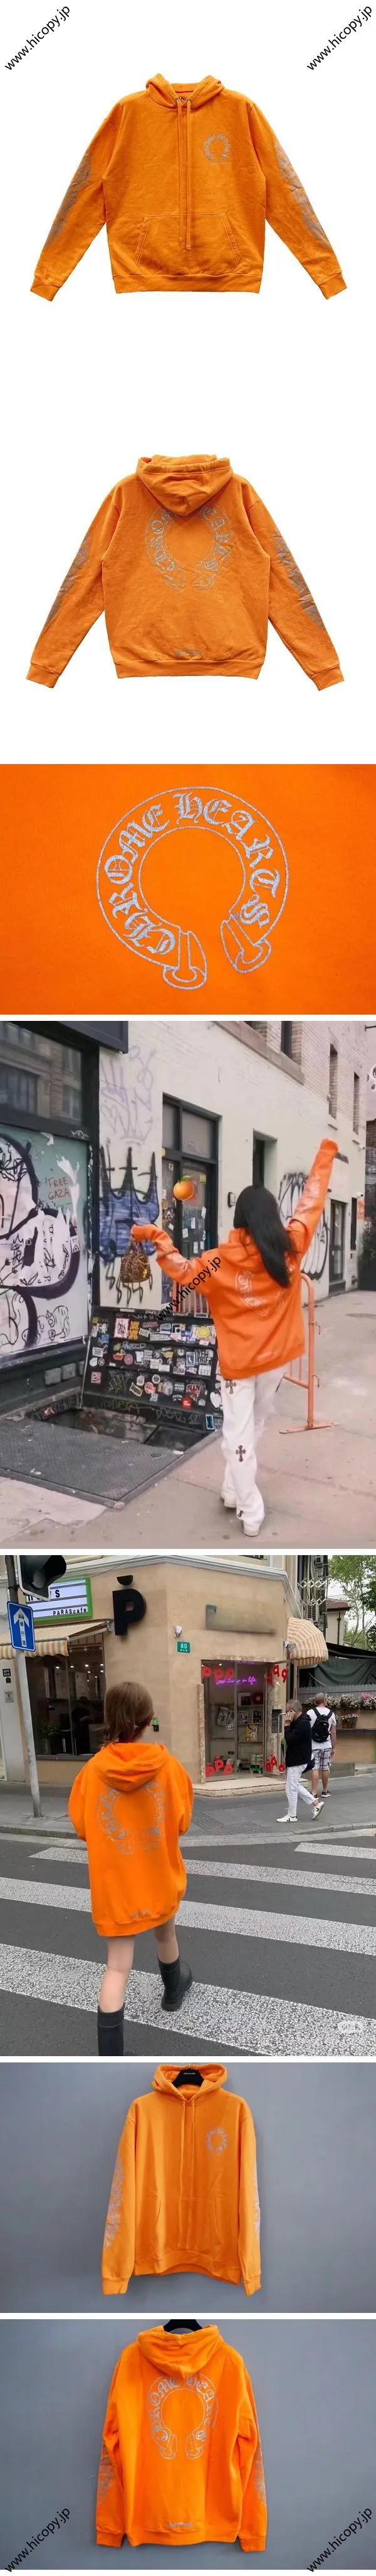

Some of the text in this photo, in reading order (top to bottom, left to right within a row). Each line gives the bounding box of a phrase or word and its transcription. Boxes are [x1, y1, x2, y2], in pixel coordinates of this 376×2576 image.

[104, 792, 281, 955] CHROME HEARTS
[48, 1177, 68, 1187] FREE
[48, 1189, 70, 1200] GAZA
